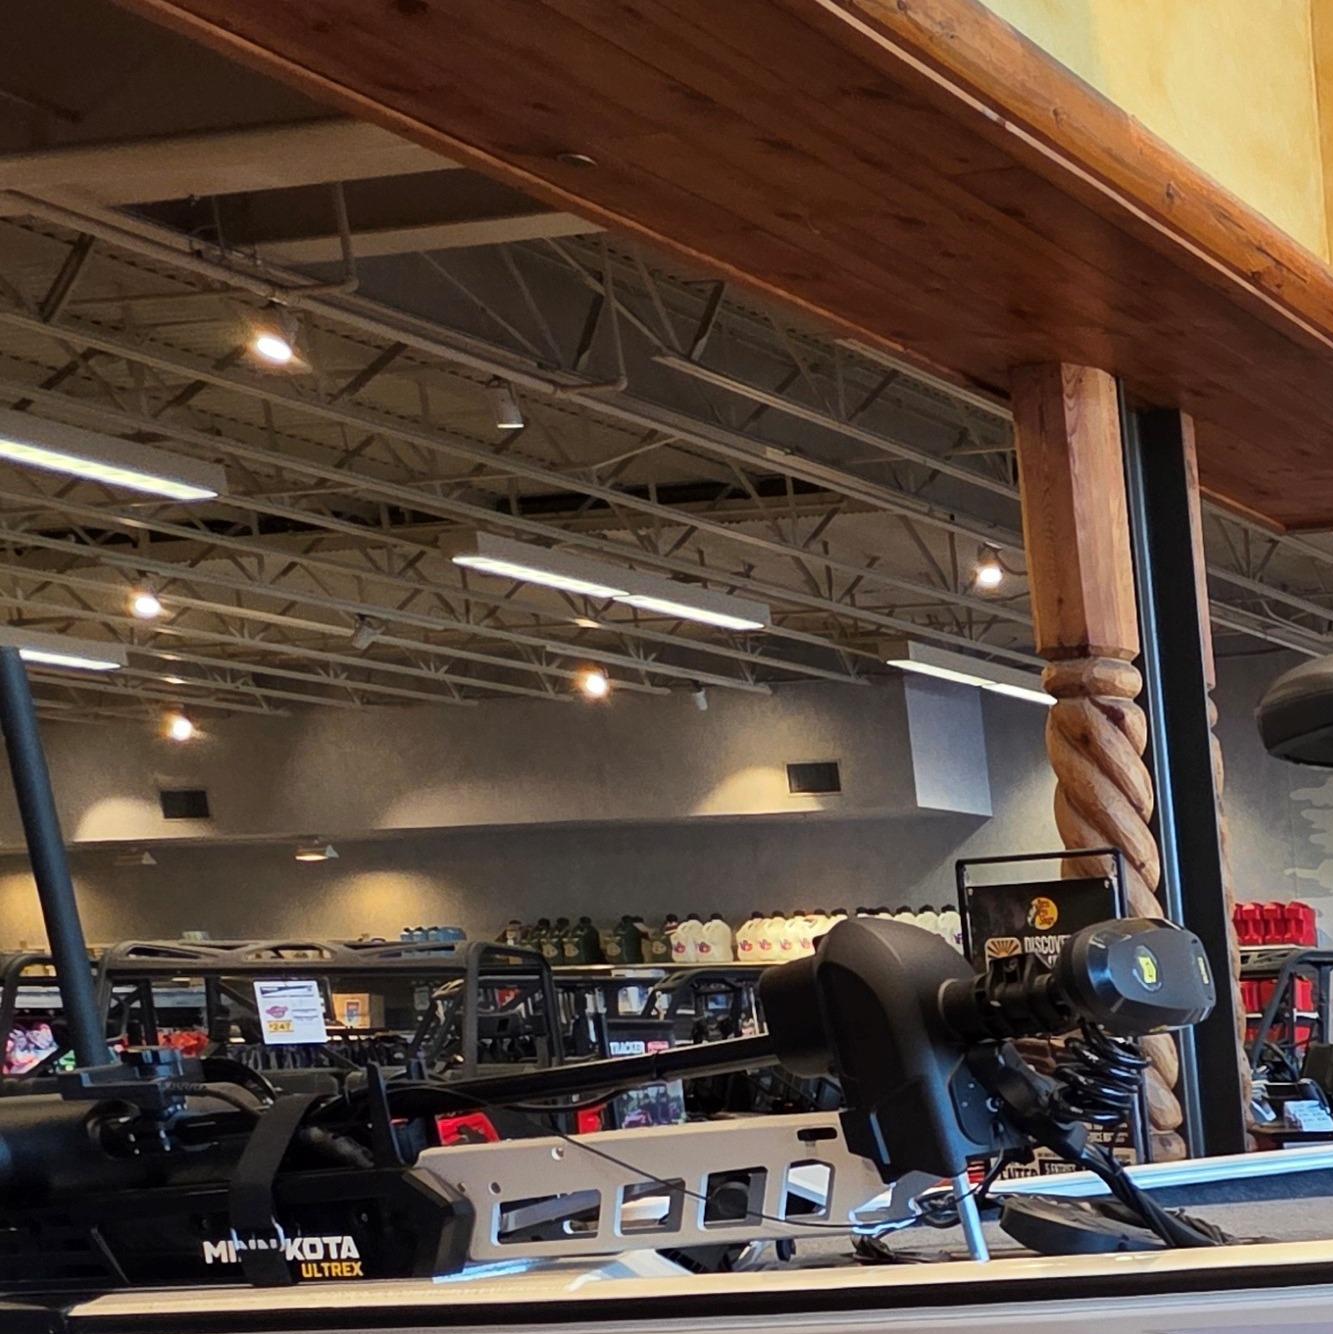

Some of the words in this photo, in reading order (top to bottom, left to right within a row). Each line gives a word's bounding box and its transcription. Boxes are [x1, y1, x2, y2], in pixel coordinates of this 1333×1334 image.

[1024, 935, 1072, 955] DISCOV
[285, 1235, 360, 1261] KOTA
[301, 1261, 364, 1278] ULTREX
